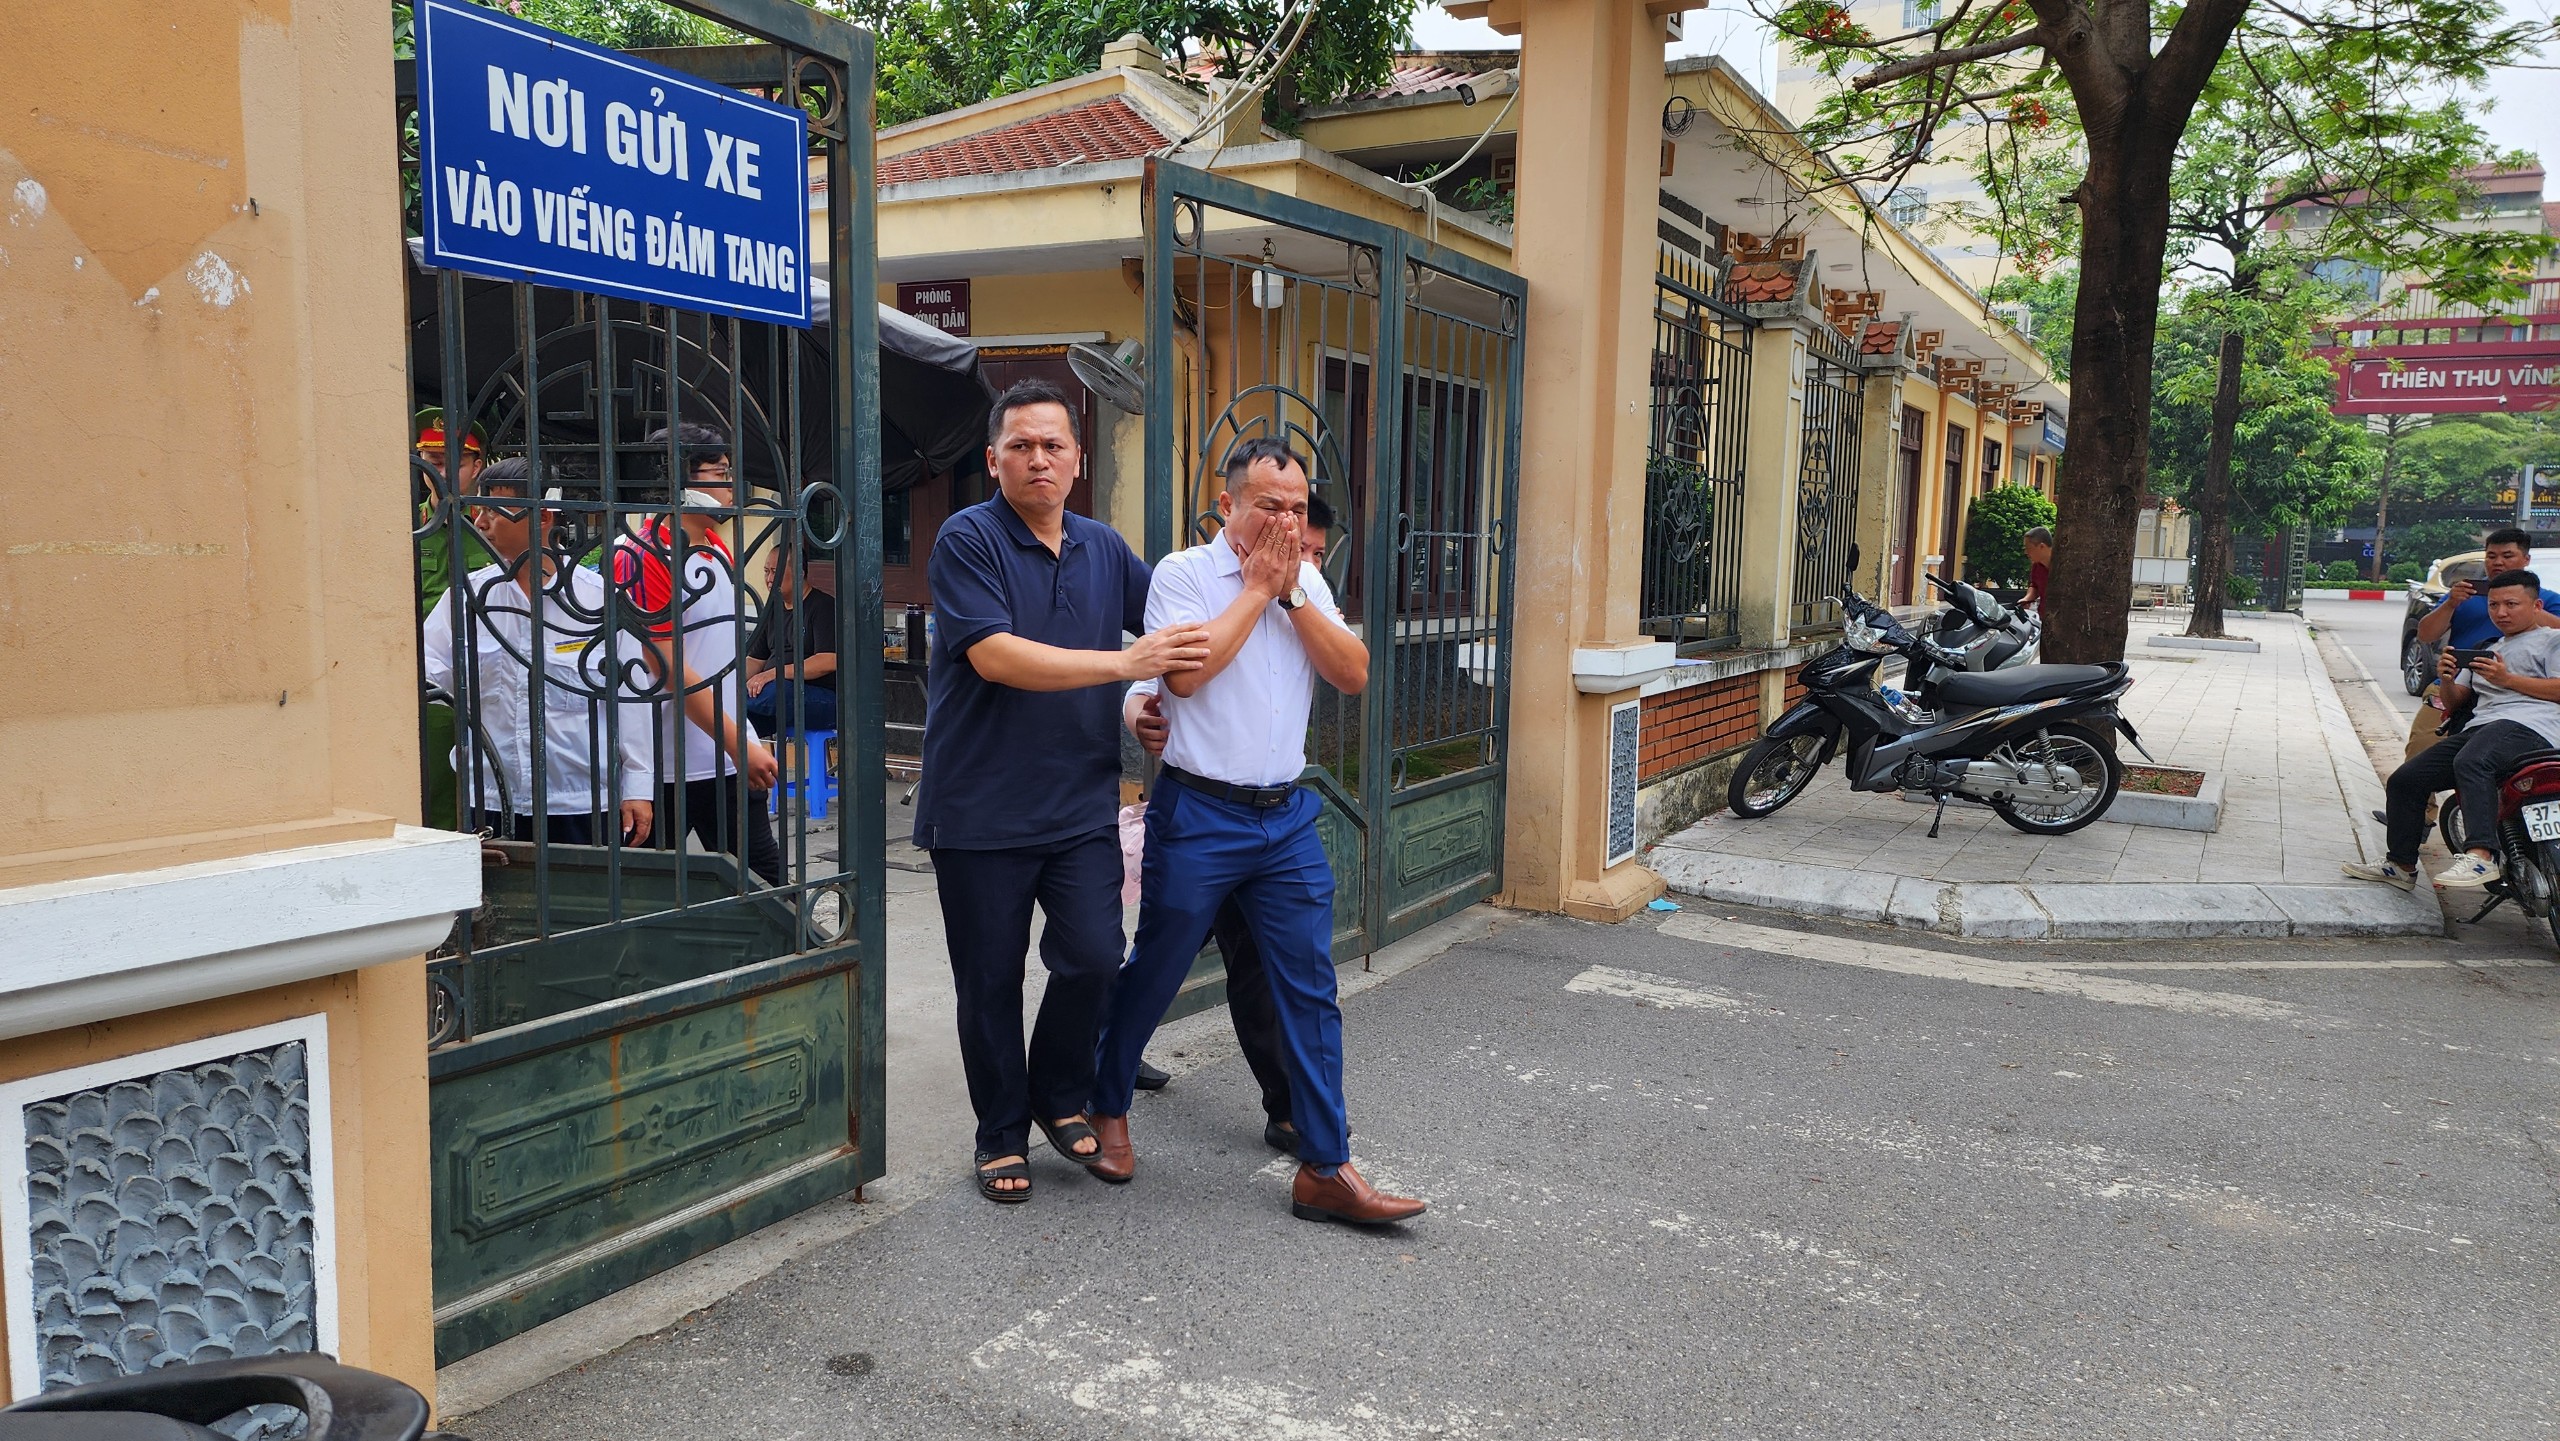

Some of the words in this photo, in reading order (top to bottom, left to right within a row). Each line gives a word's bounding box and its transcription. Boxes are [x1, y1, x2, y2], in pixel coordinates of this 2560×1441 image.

[488, 65, 587, 154] NƠI
[605, 86, 689, 181] GỬI
[704, 128, 762, 200] XE
[445, 159, 522, 236] VÀO
[533, 184, 636, 261] VIẾNG
[645, 211, 716, 277] ĐÁM
[723, 233, 795, 293] TANG
[915, 287, 952, 305] PHÒNG
[914, 309, 939, 328] ỚNG
[942, 306, 966, 328] DẪN
[2378, 367, 2446, 389] THIÊN
[2452, 368, 2501, 387] THU
[2532, 805, 2560, 821] 37-
